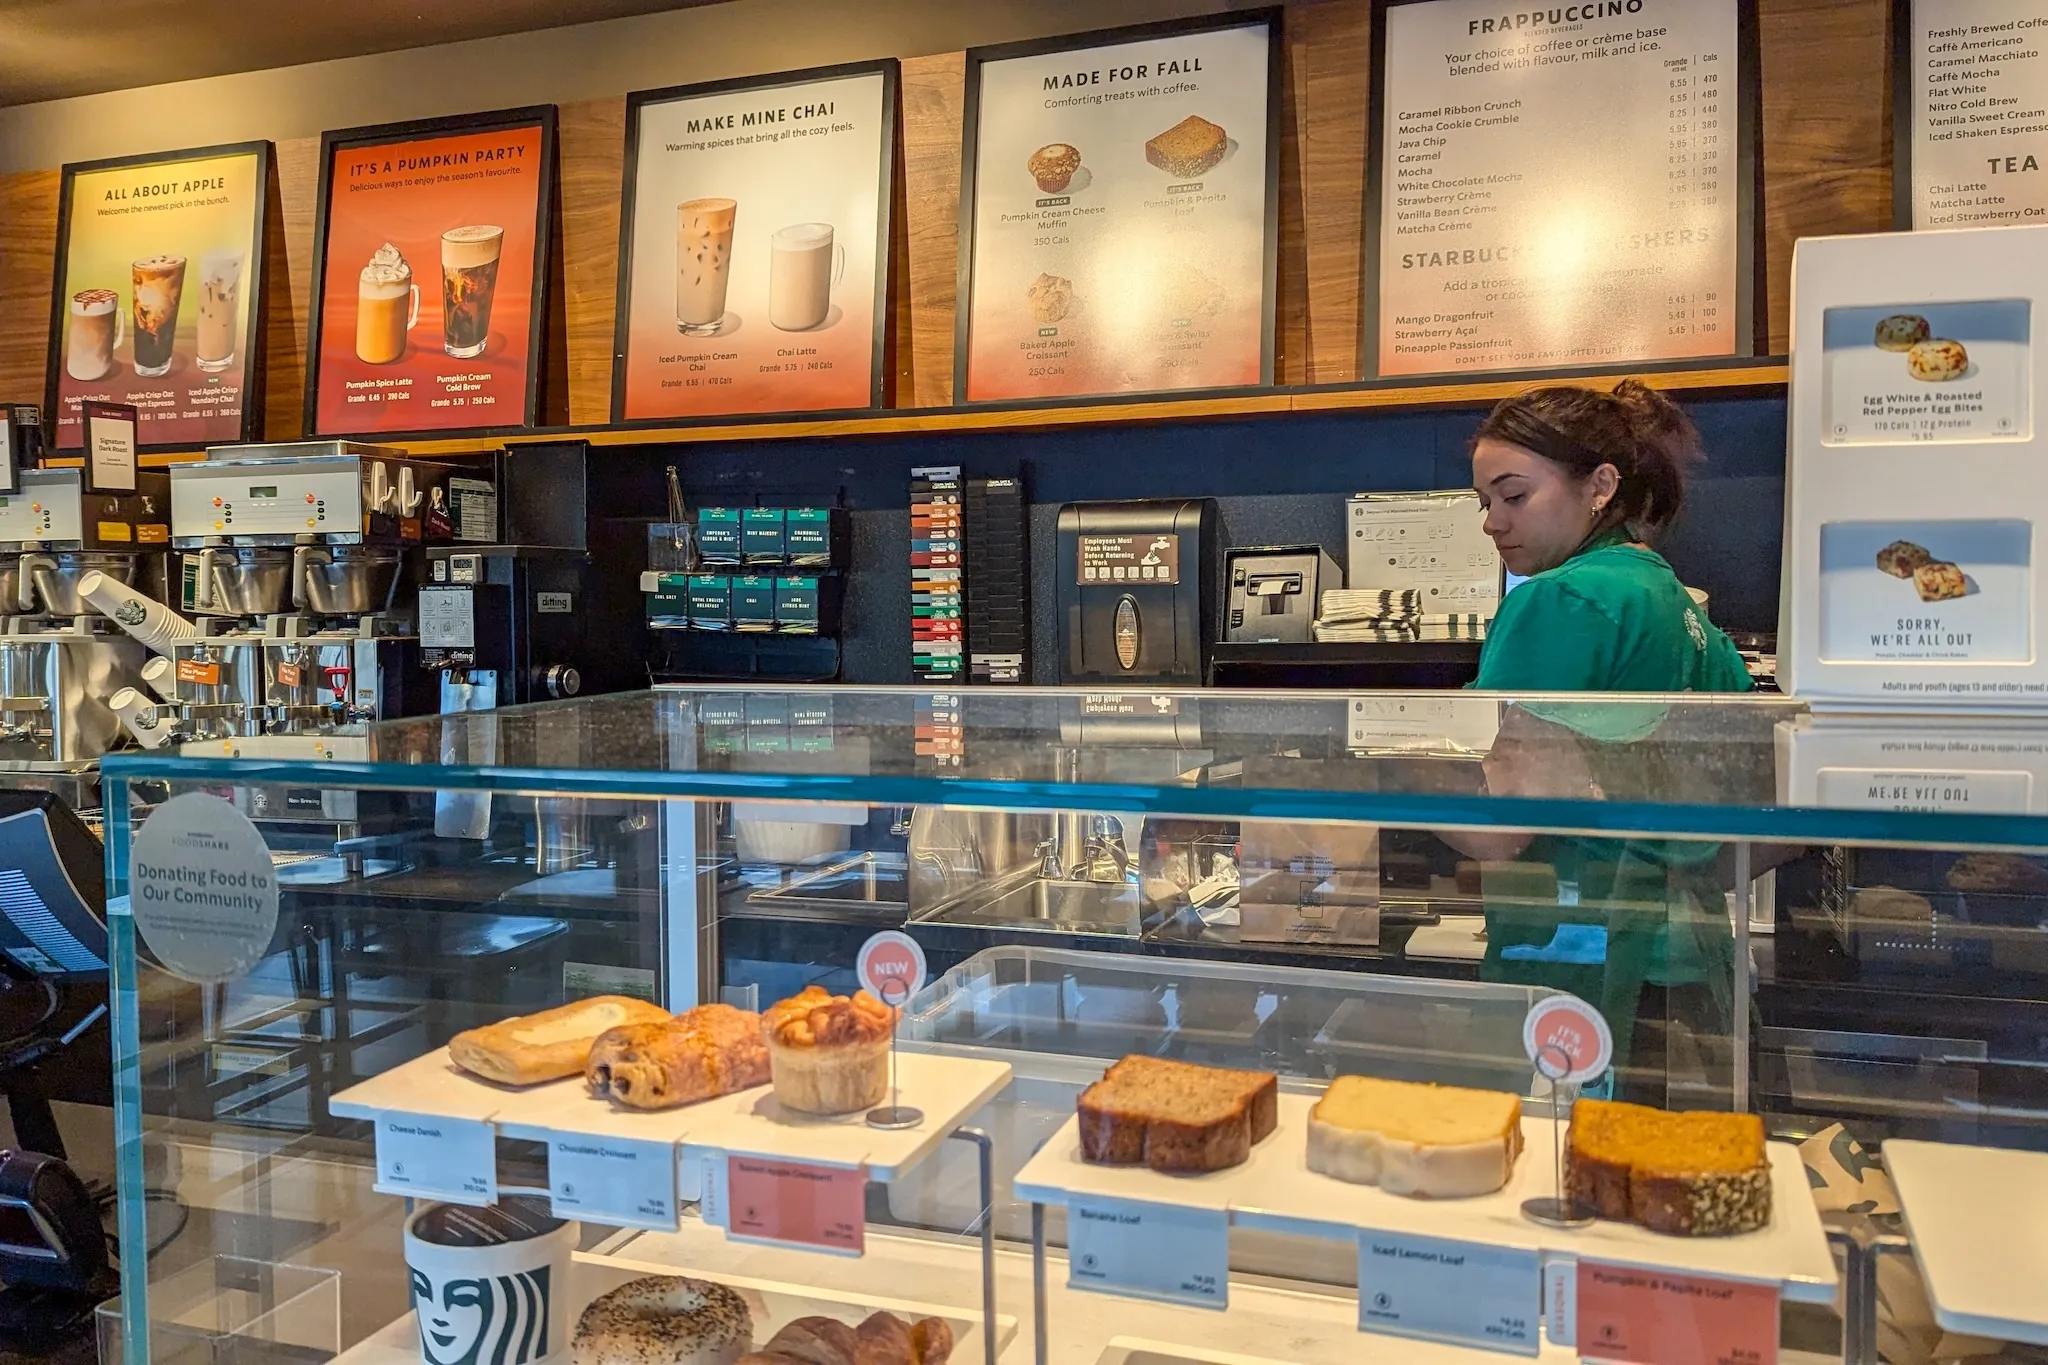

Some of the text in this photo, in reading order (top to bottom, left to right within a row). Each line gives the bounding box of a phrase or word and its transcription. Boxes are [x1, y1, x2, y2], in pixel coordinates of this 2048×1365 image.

[1468, 0, 1643, 35] FRAPPUCCINO
[1445, 26, 1667, 64] Your choice of coffee or crème base
[1450, 41, 1661, 76] blended with flavour, milk and ice.
[1664, 54, 1717, 67] Grande Cals
[1043, 58, 1202, 90] MADE FOR FALL
[1670, 75, 1717, 88] 6.55 470
[1044, 82, 1199, 108] Comforting treats with coffee.
[1399, 99, 1521, 120] Caramel Ribbon Crunch
[1929, 97, 2018, 112] Nitro Cold Brew
[687, 102, 835, 134] MAKE MINE CHAI
[1399, 115, 1519, 134] Mocha Cookie Crumble
[1929, 108, 2045, 126] Vanilla Sweet Cream
[666, 122, 855, 152] Warming spices that bring all the cozy feels.
[1398, 138, 1446, 149] Java Chip
[351, 146, 525, 176] IT'S A PUMPKIN PARTY
[1398, 152, 1440, 163] Caramel
[1988, 155, 2039, 174] TEA
[1398, 167, 1433, 177] Mocha
[105, 178, 224, 201] ALL ABOUT APPLE
[1398, 173, 1522, 192] White Chocolate Mocha
[1930, 183, 1986, 194] Chai Latte
[1930, 196, 2005, 209] Matcha Latte
[1001, 206, 1105, 223] Pumpkin Cream Cheese
[1930, 208, 2045, 224] Iced Strawberry Oat
[1038, 220, 1067, 230] Muffin
[1034, 236, 1070, 246] 350 Cals
[1396, 310, 1494, 325] Mango Dragonfruit
[1395, 338, 1512, 354] Pineapple Passionfruit
[346, 378, 413, 389] Pumpkin Spice Latte
[437, 375, 466, 383] Pumpkin
[1864, 396, 1882, 404] Egg
[1936, 391, 1982, 401] Roasted
[1888, 406, 1927, 415] Pepper
[1932, 405, 1951, 414] Egg
[100, 438, 125, 446] Signature
[542, 596, 566, 608] ditting
[1897, 619, 1945, 631] SORRY,
[1871, 634, 1972, 646] WE'RE ALL OUT
[451, 651, 473, 663] ditting
[172, 838, 229, 850] FOODSHARE
[138, 863, 267, 888] Donating Food to
[143, 885, 262, 913] Our Community
[875, 962, 908, 975] NEW
[390, 1124, 416, 1135] Cheese
[559, 1144, 636, 1160] Chocolate Croissant
[1080, 1208, 1140, 1225] Banana Loaf
[1373, 1245, 1464, 1265] Iced Lemon Loaf
